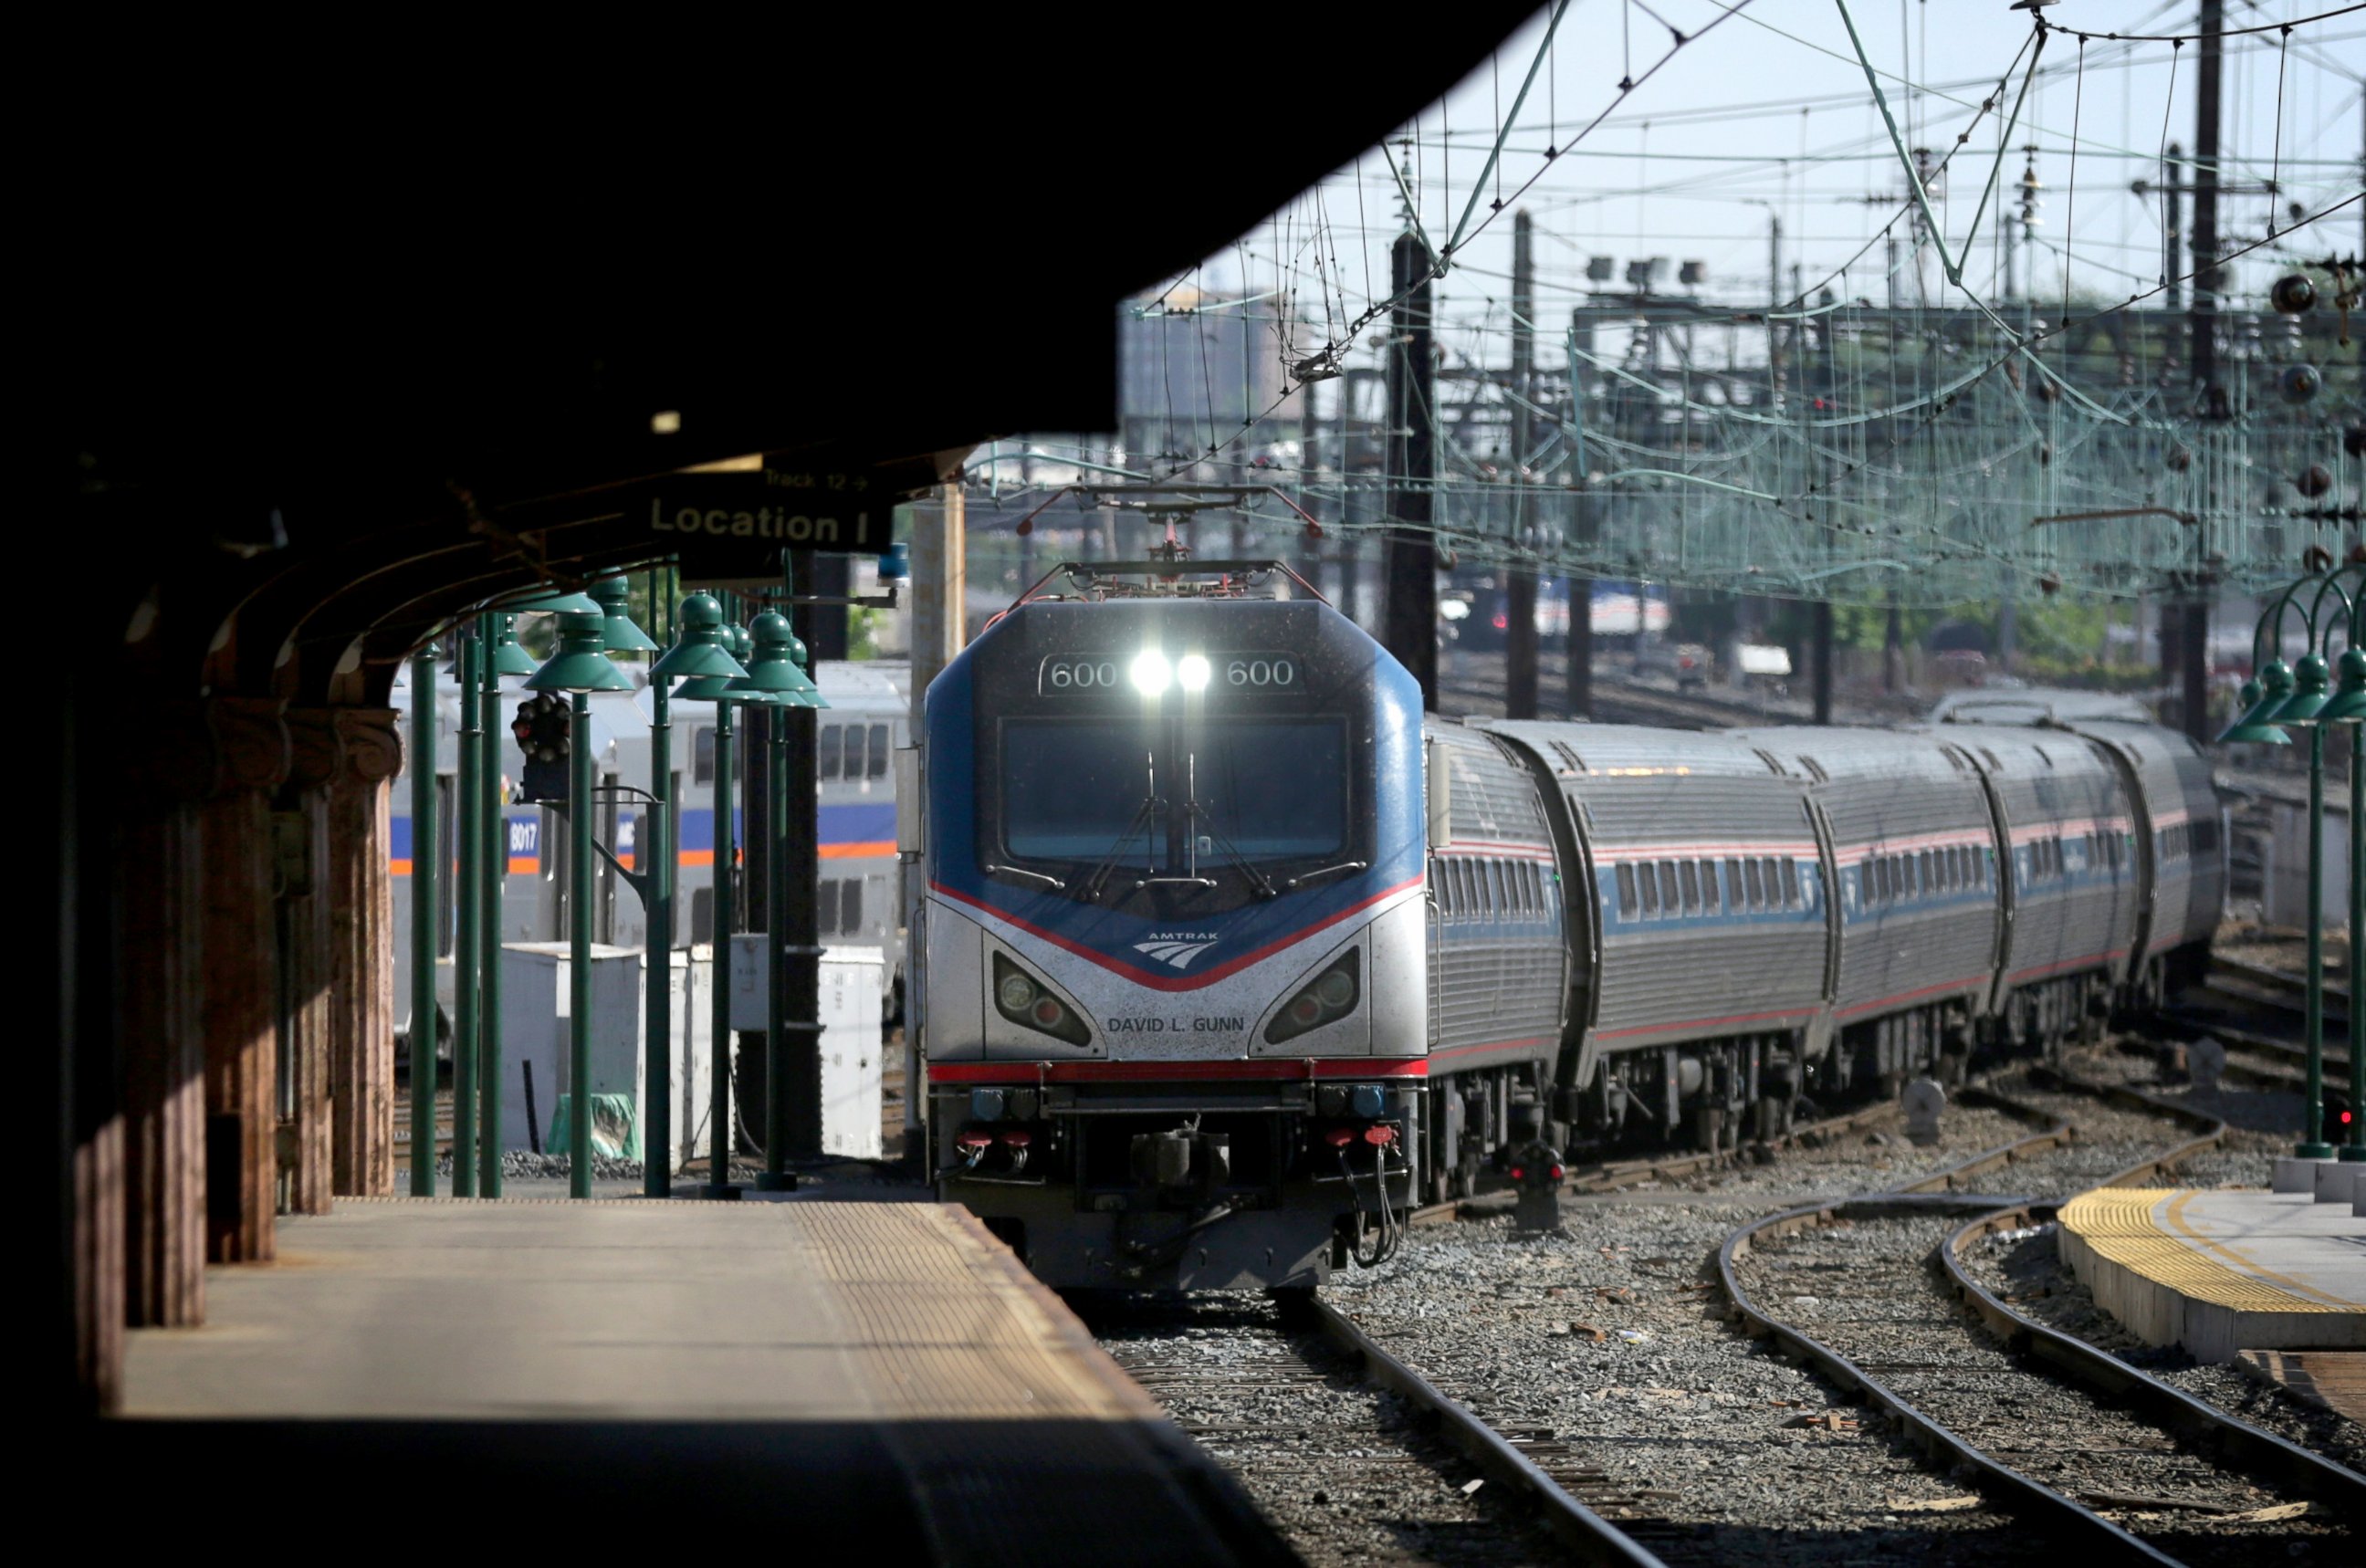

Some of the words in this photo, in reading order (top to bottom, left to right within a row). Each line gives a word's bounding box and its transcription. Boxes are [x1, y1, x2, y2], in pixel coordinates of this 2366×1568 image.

[765, 468, 816, 488] Track
[826, 473, 846, 491] 12
[650, 497, 840, 543] Location
[1051, 663, 1116, 687] 600
[1227, 660, 1293, 685] 600
[509, 822, 538, 852] 8017
[1148, 932, 1220, 941] AMTRAK
[1108, 1018, 1165, 1032] DAVID
[1171, 1018, 1186, 1032] L.
[1192, 1017, 1244, 1031] GUNN
